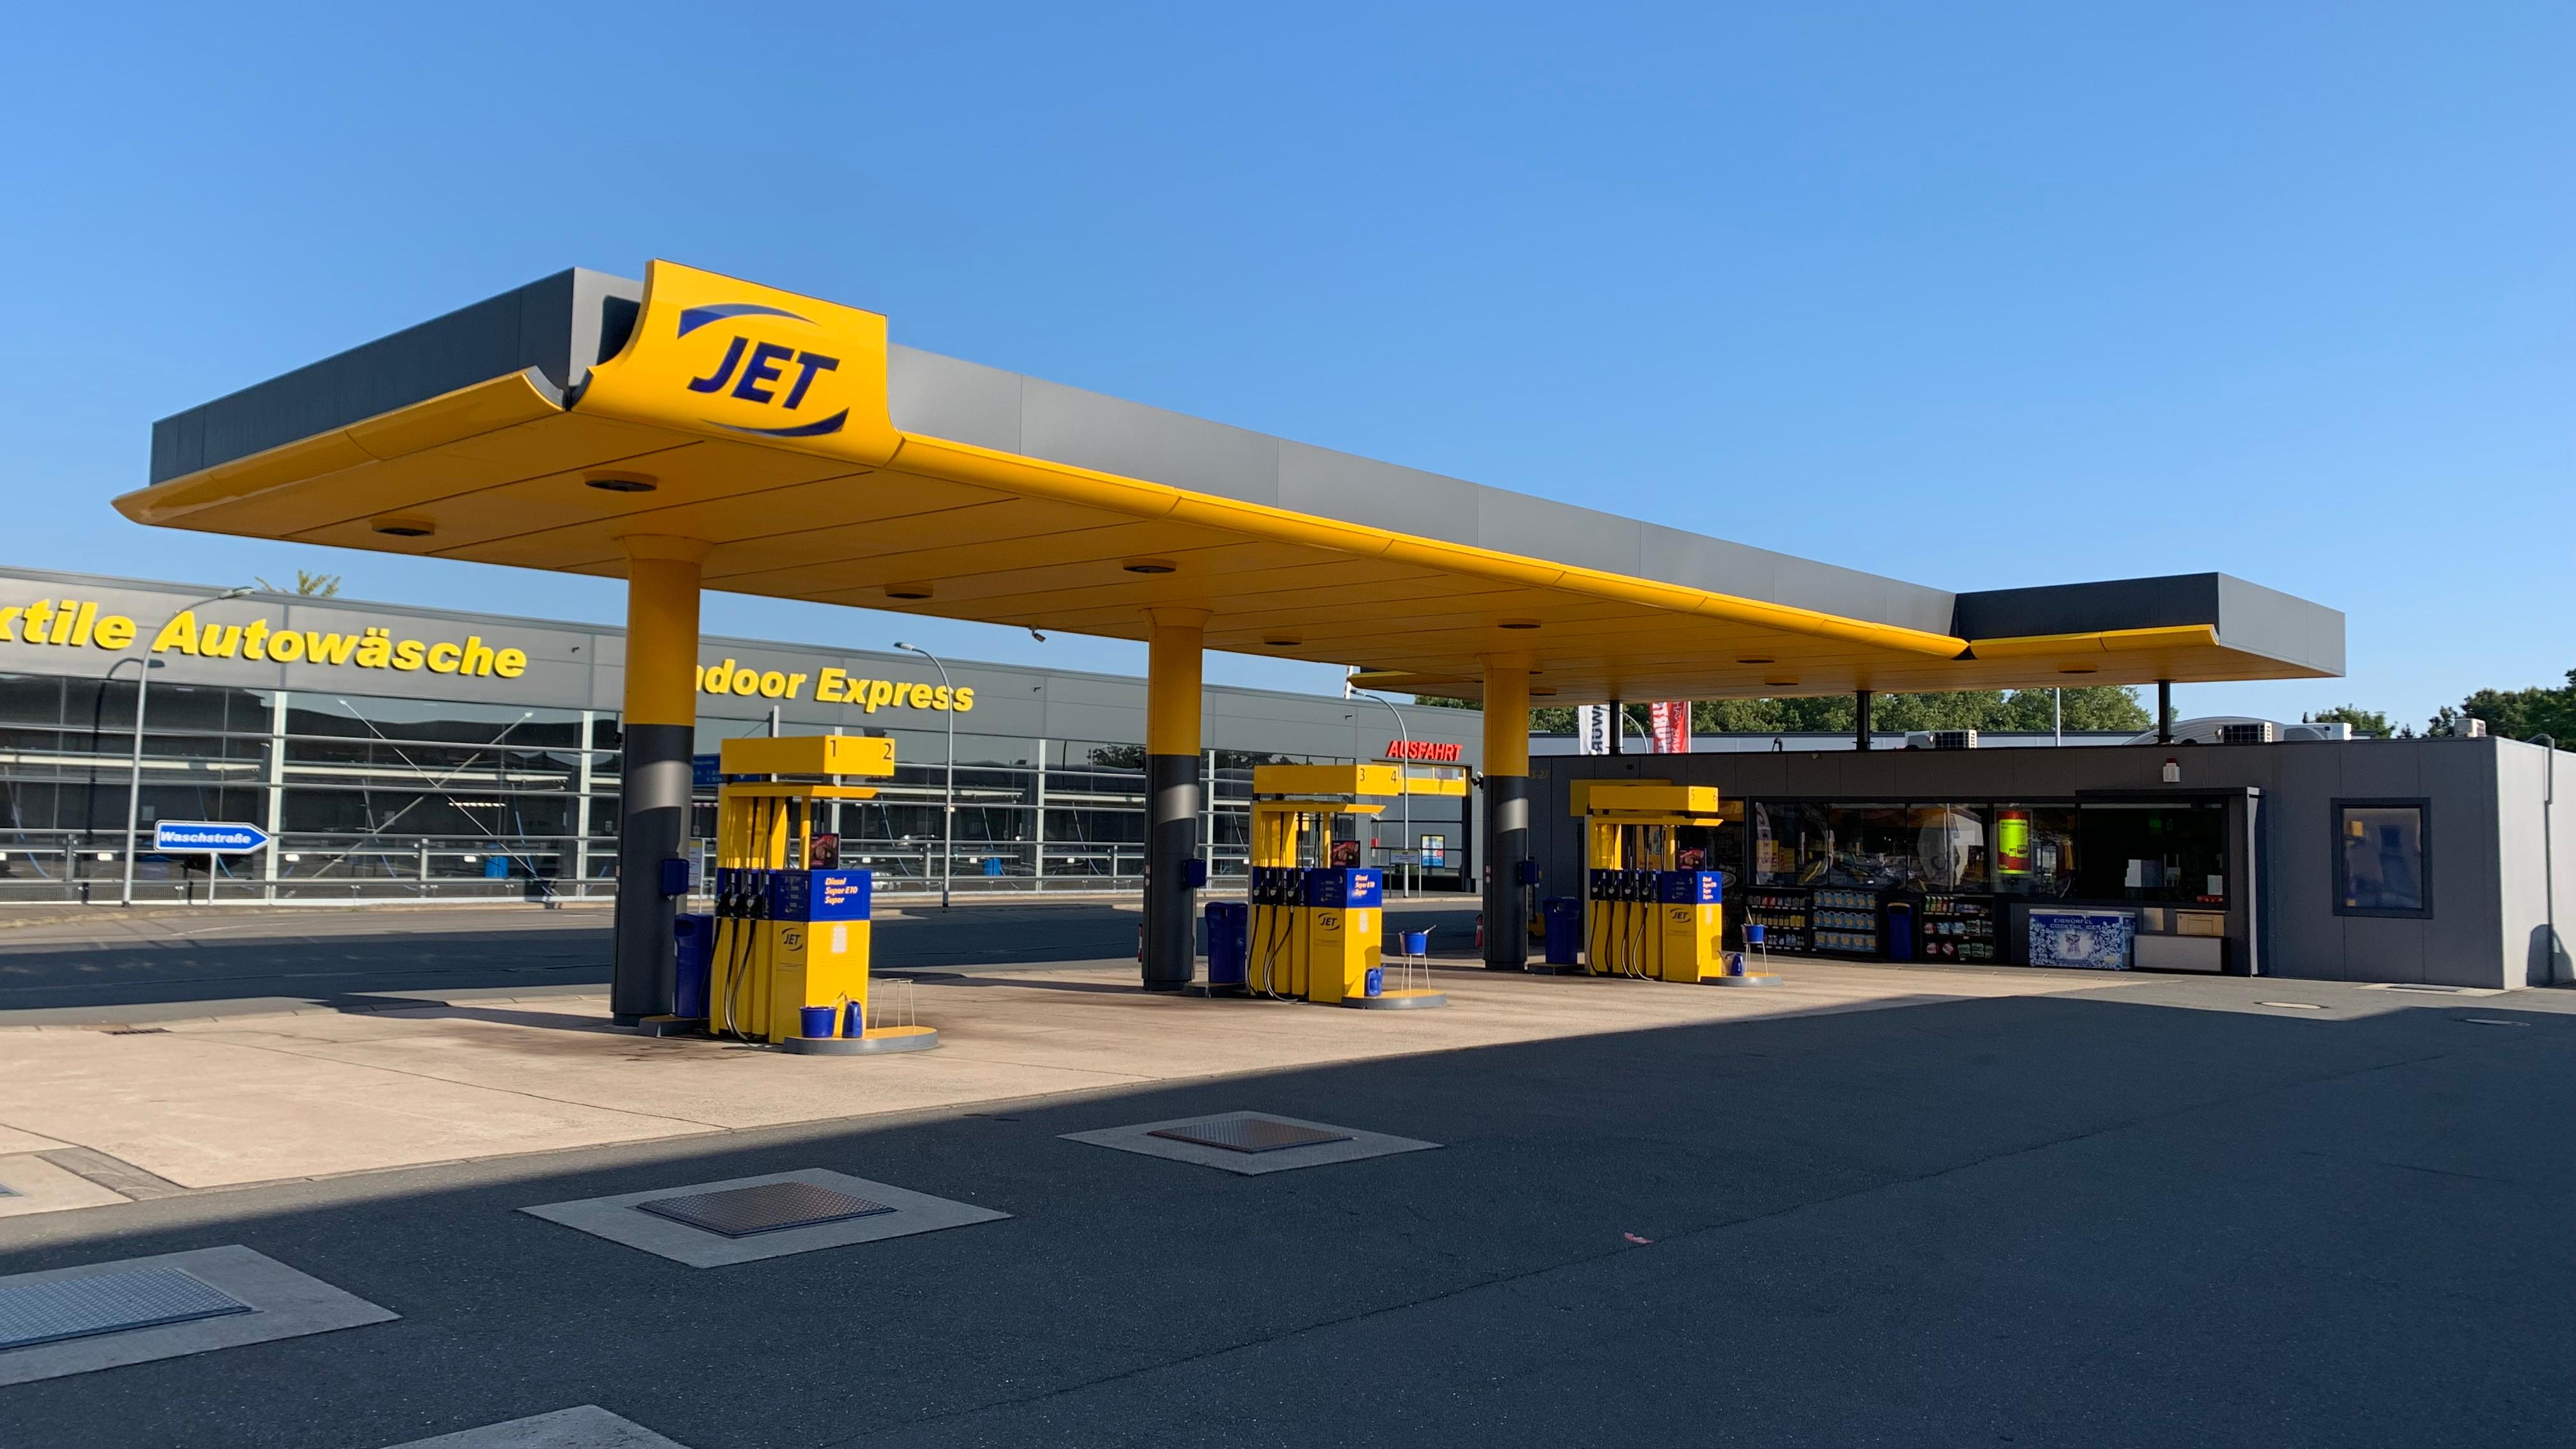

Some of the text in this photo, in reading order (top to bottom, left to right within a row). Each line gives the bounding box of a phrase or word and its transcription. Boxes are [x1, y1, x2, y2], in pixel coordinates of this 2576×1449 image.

[686, 335, 841, 411] JET
[151, 610, 527, 679] Autowäsche
[696, 659, 975, 714] door Express
[829, 739, 893, 760] 1 2
[1385, 740, 1462, 762] AUSFAHRT
[1359, 768, 1397, 783] 3 4
[1691, 789, 1717, 802] 5 6
[160, 831, 252, 844] Waschstraße
[804, 880, 808, 890] 1
[825, 877, 847, 885] Diesel
[824, 885, 858, 896] Super E10
[824, 896, 845, 906] Super
[1320, 917, 1338, 926] JET
[783, 934, 801, 946] JET
